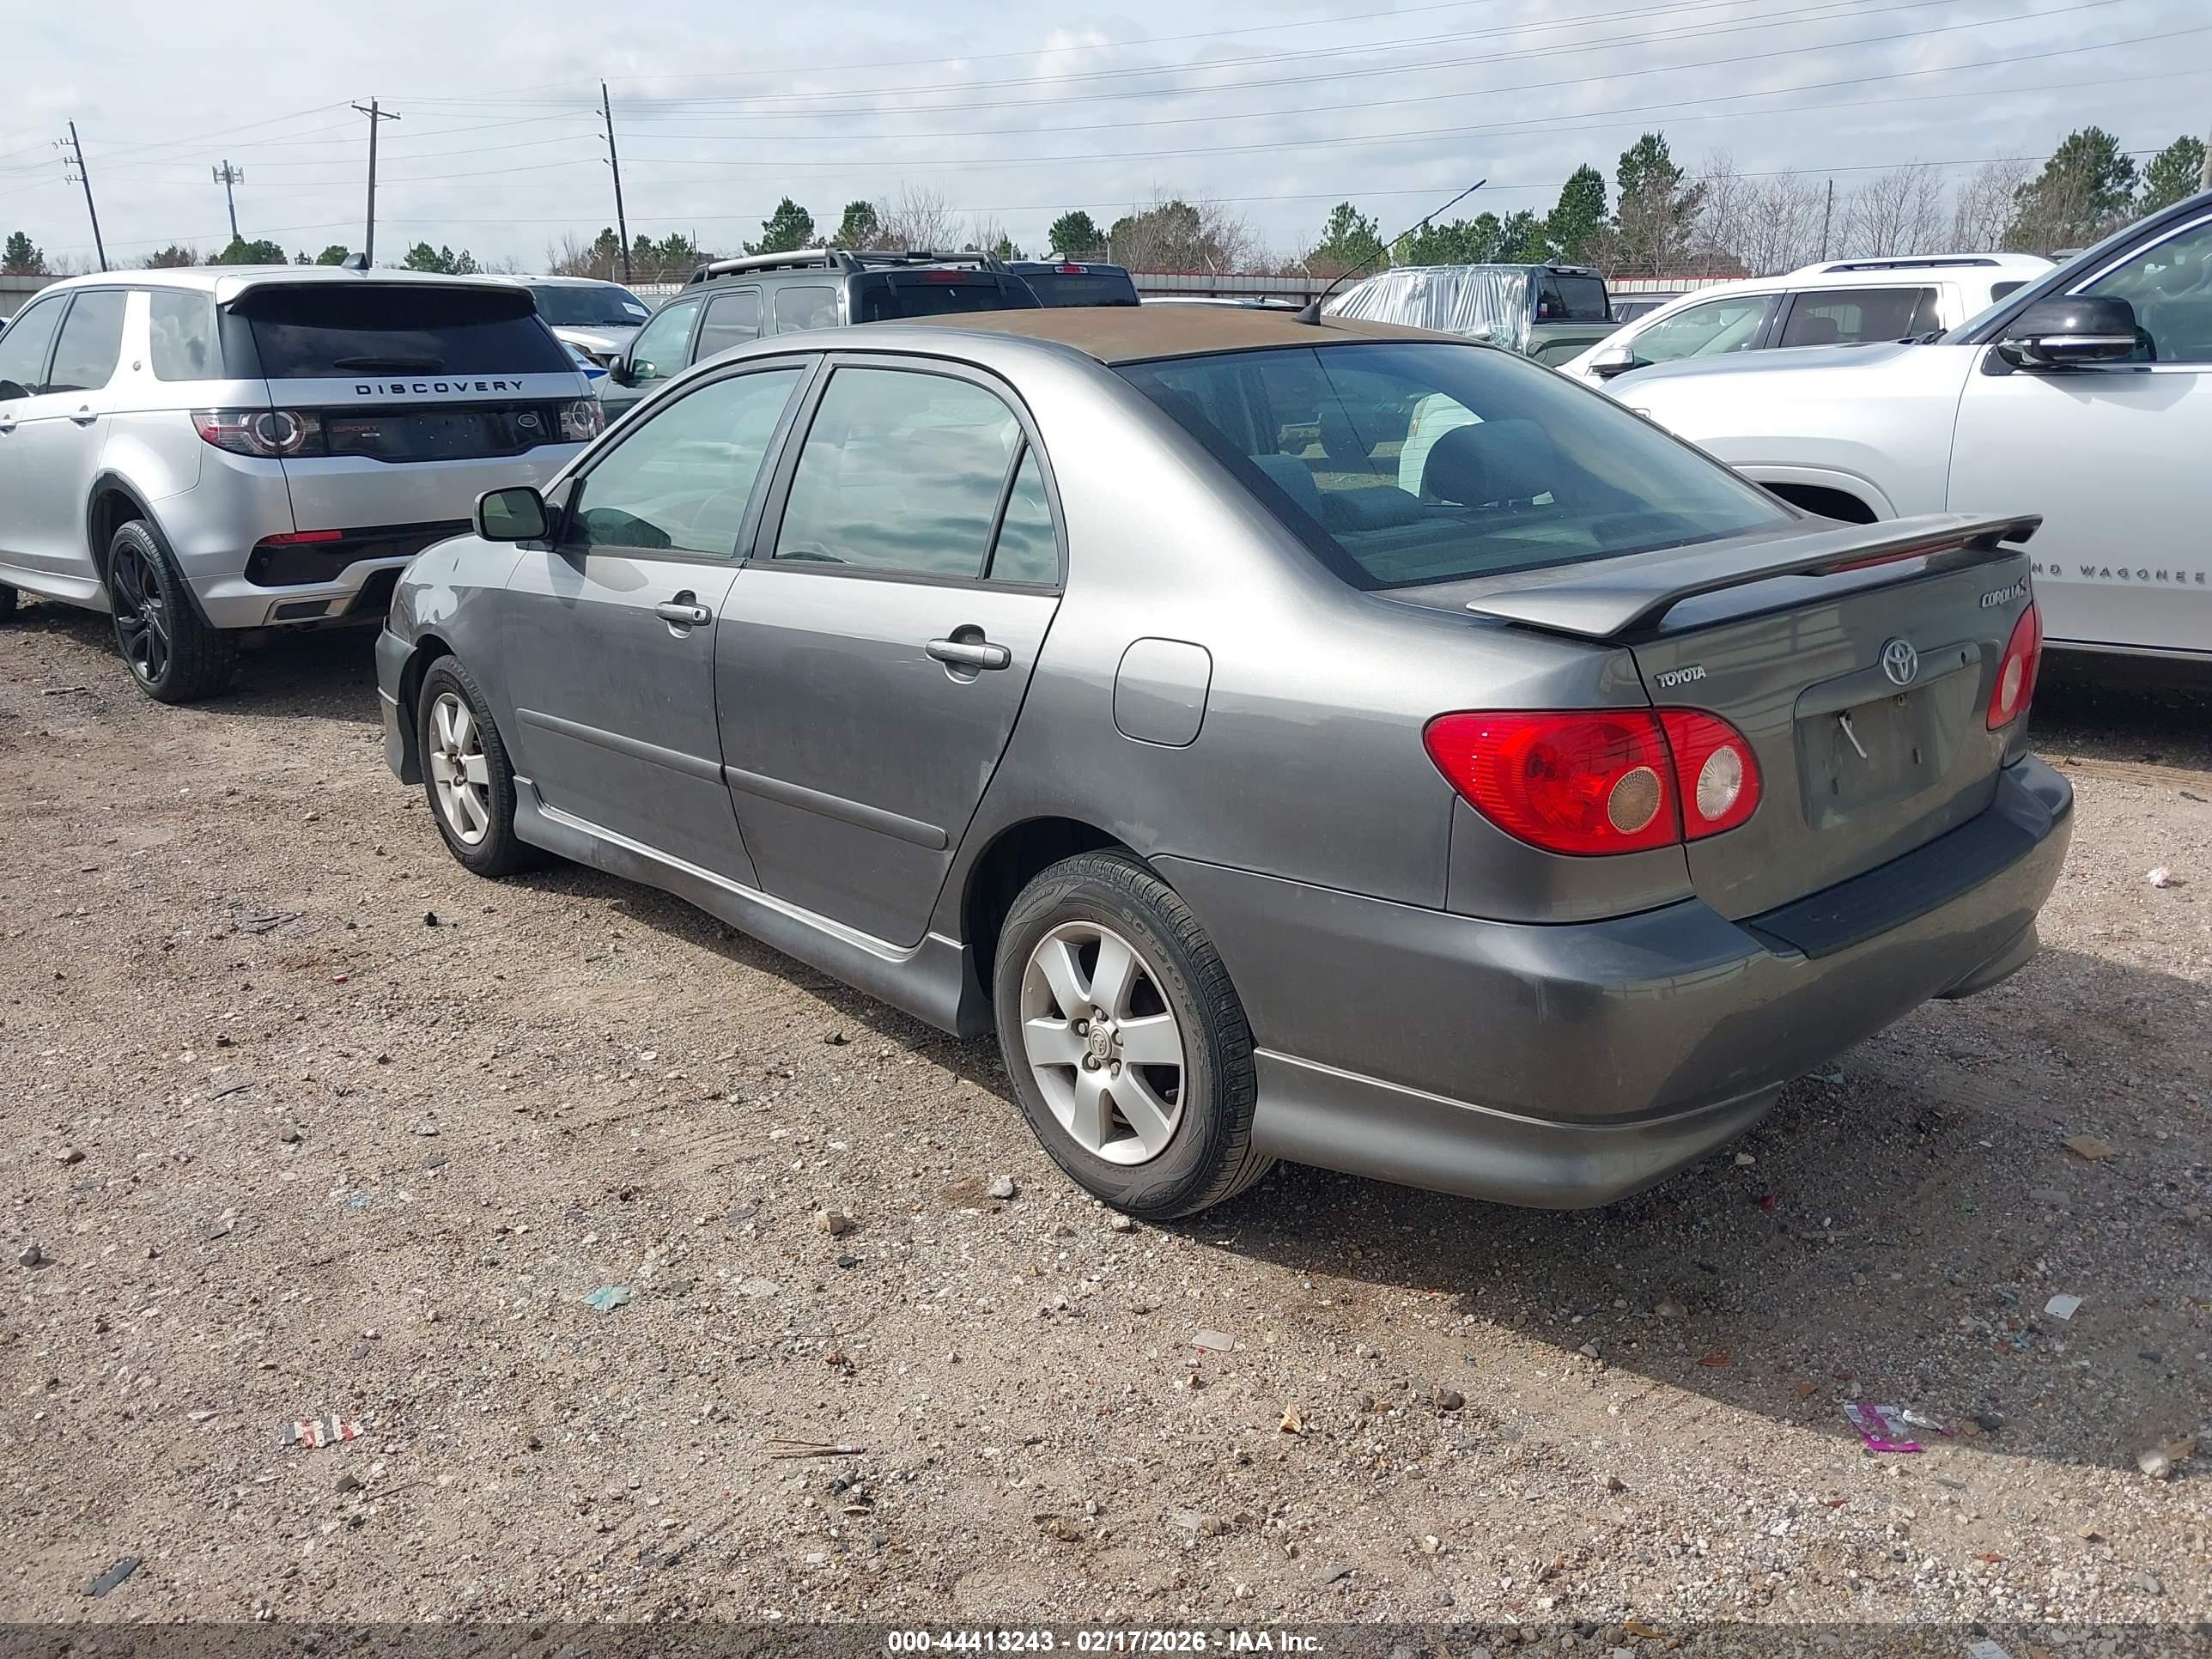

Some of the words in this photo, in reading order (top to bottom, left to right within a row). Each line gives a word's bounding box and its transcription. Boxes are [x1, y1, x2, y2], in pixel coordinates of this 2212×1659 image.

[356, 380, 523, 395] DISCOVERY
[2080, 564, 2206, 583] WAGONEE
[1980, 584, 2021, 608] COROLLA
[1655, 665, 1707, 688] TOYOTA
